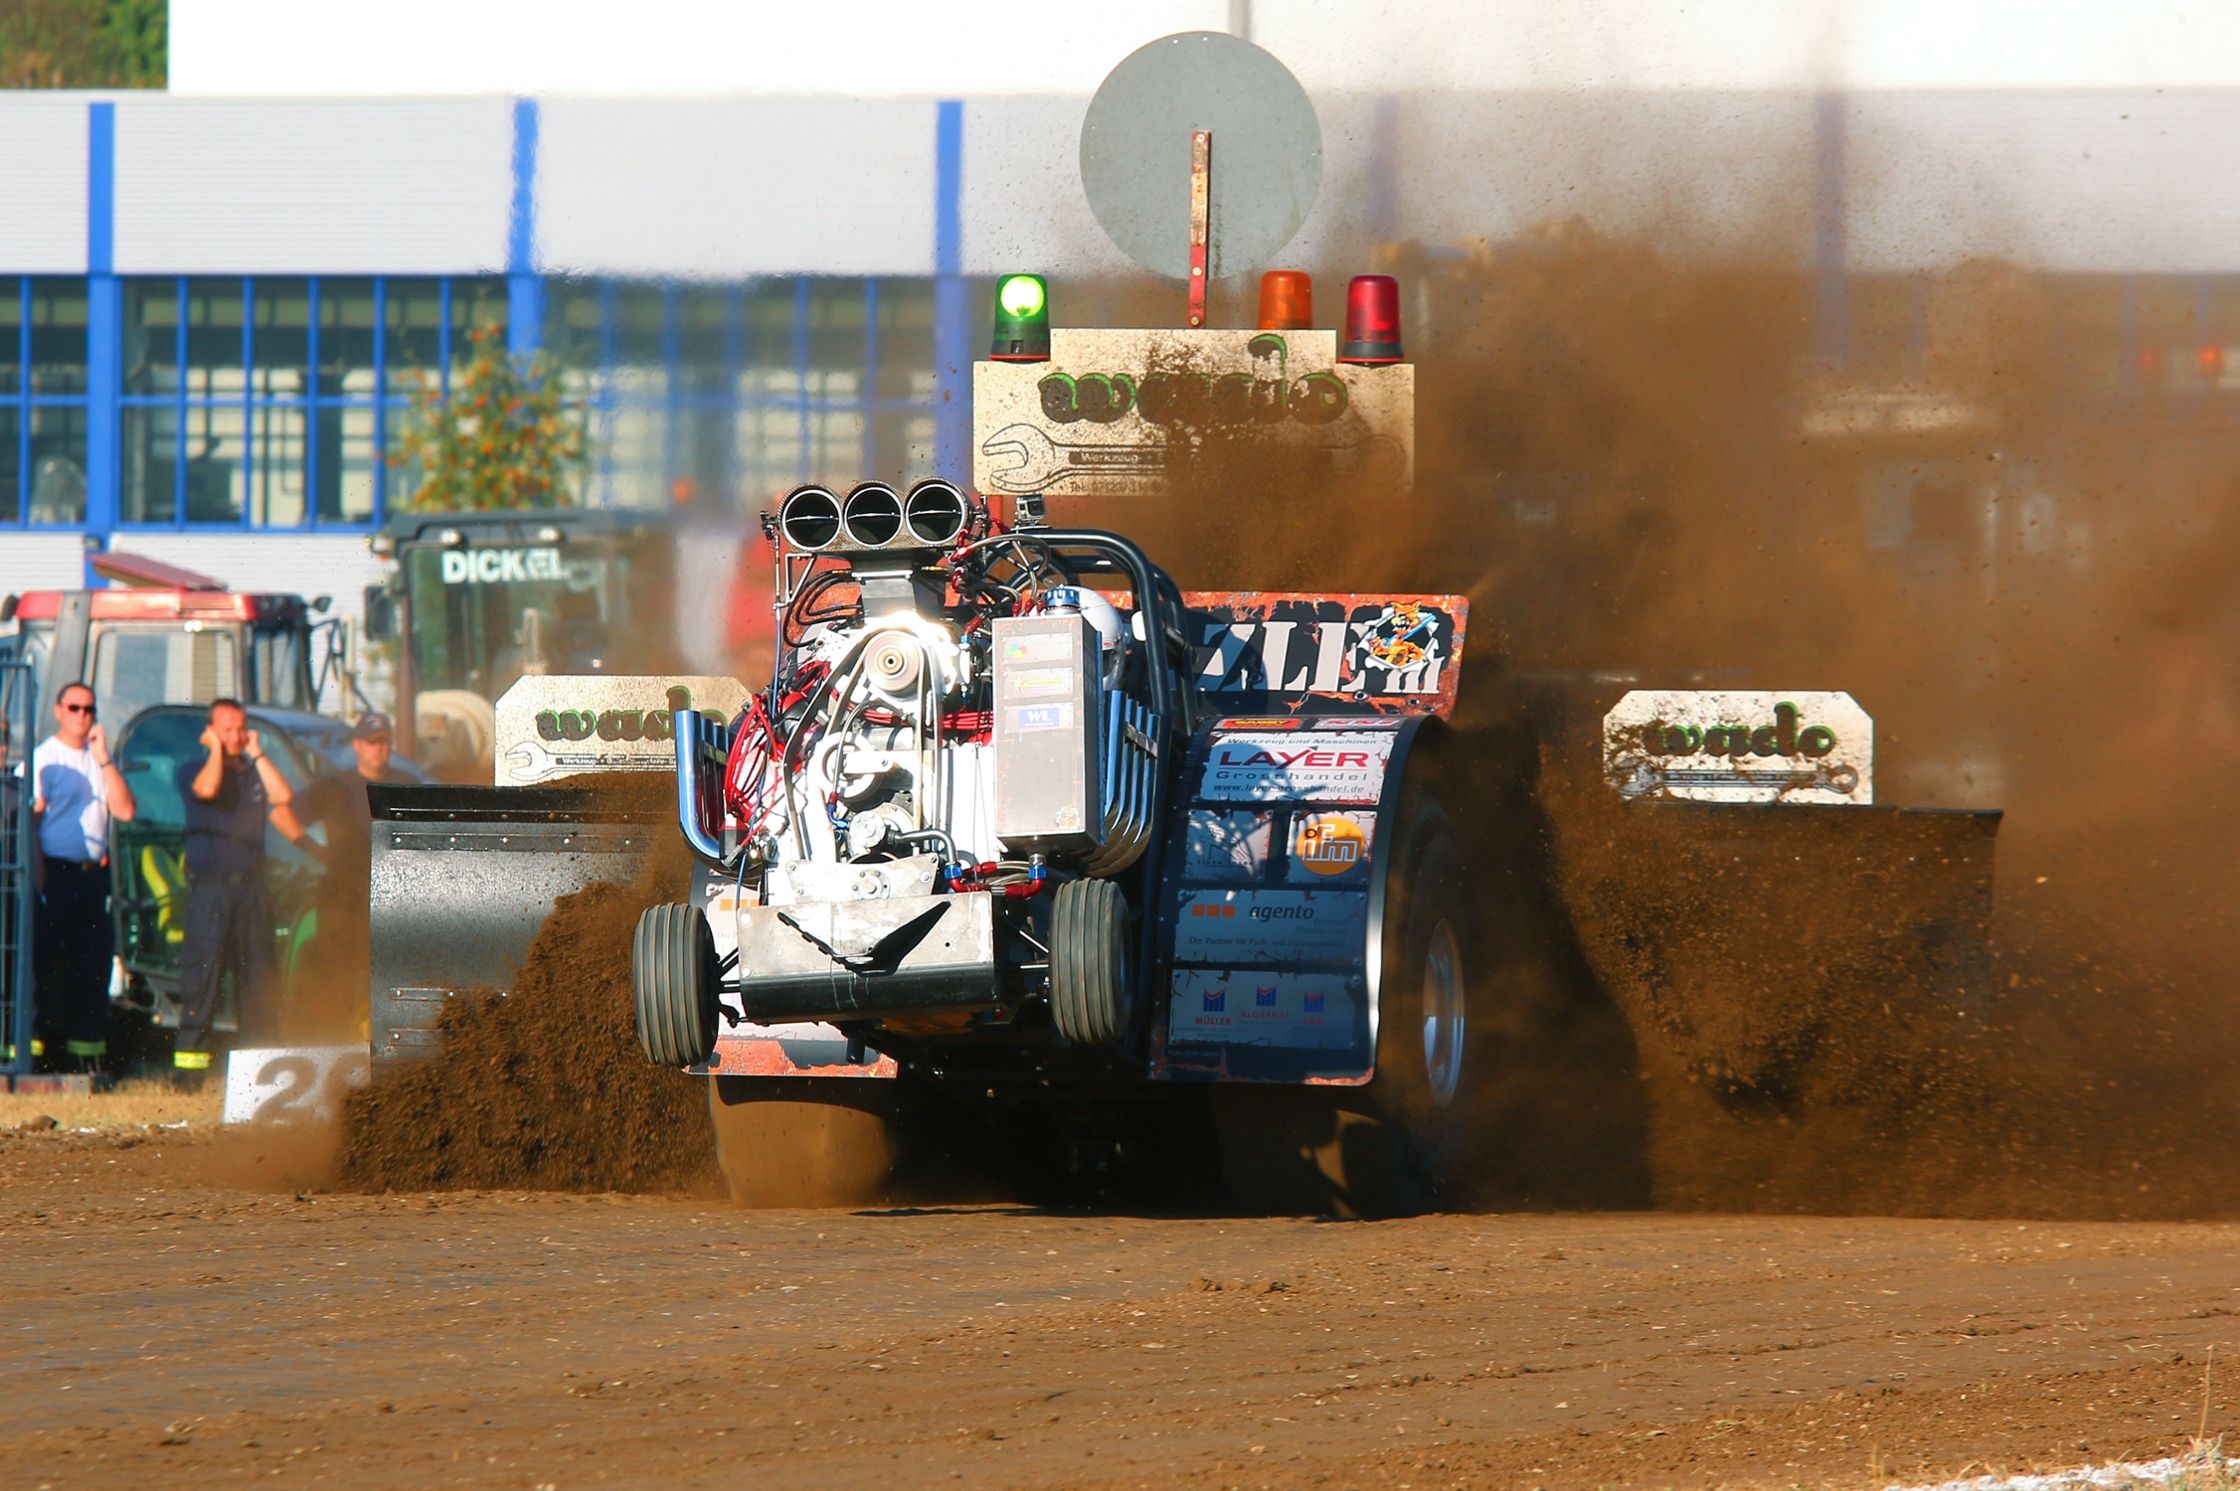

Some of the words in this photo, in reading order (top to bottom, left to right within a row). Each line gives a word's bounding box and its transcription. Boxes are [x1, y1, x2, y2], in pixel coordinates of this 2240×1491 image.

[1026, 710, 1051, 722] WL
[1227, 738, 1286, 746] Werkzeug
[1219, 748, 1370, 770] LAYER
[1216, 771, 1368, 781] Grosshandel
[1213, 784, 1365, 793] www.layer-grosshandel.de
[1302, 823, 1358, 862] ifm
[1249, 905, 1314, 923] agento
